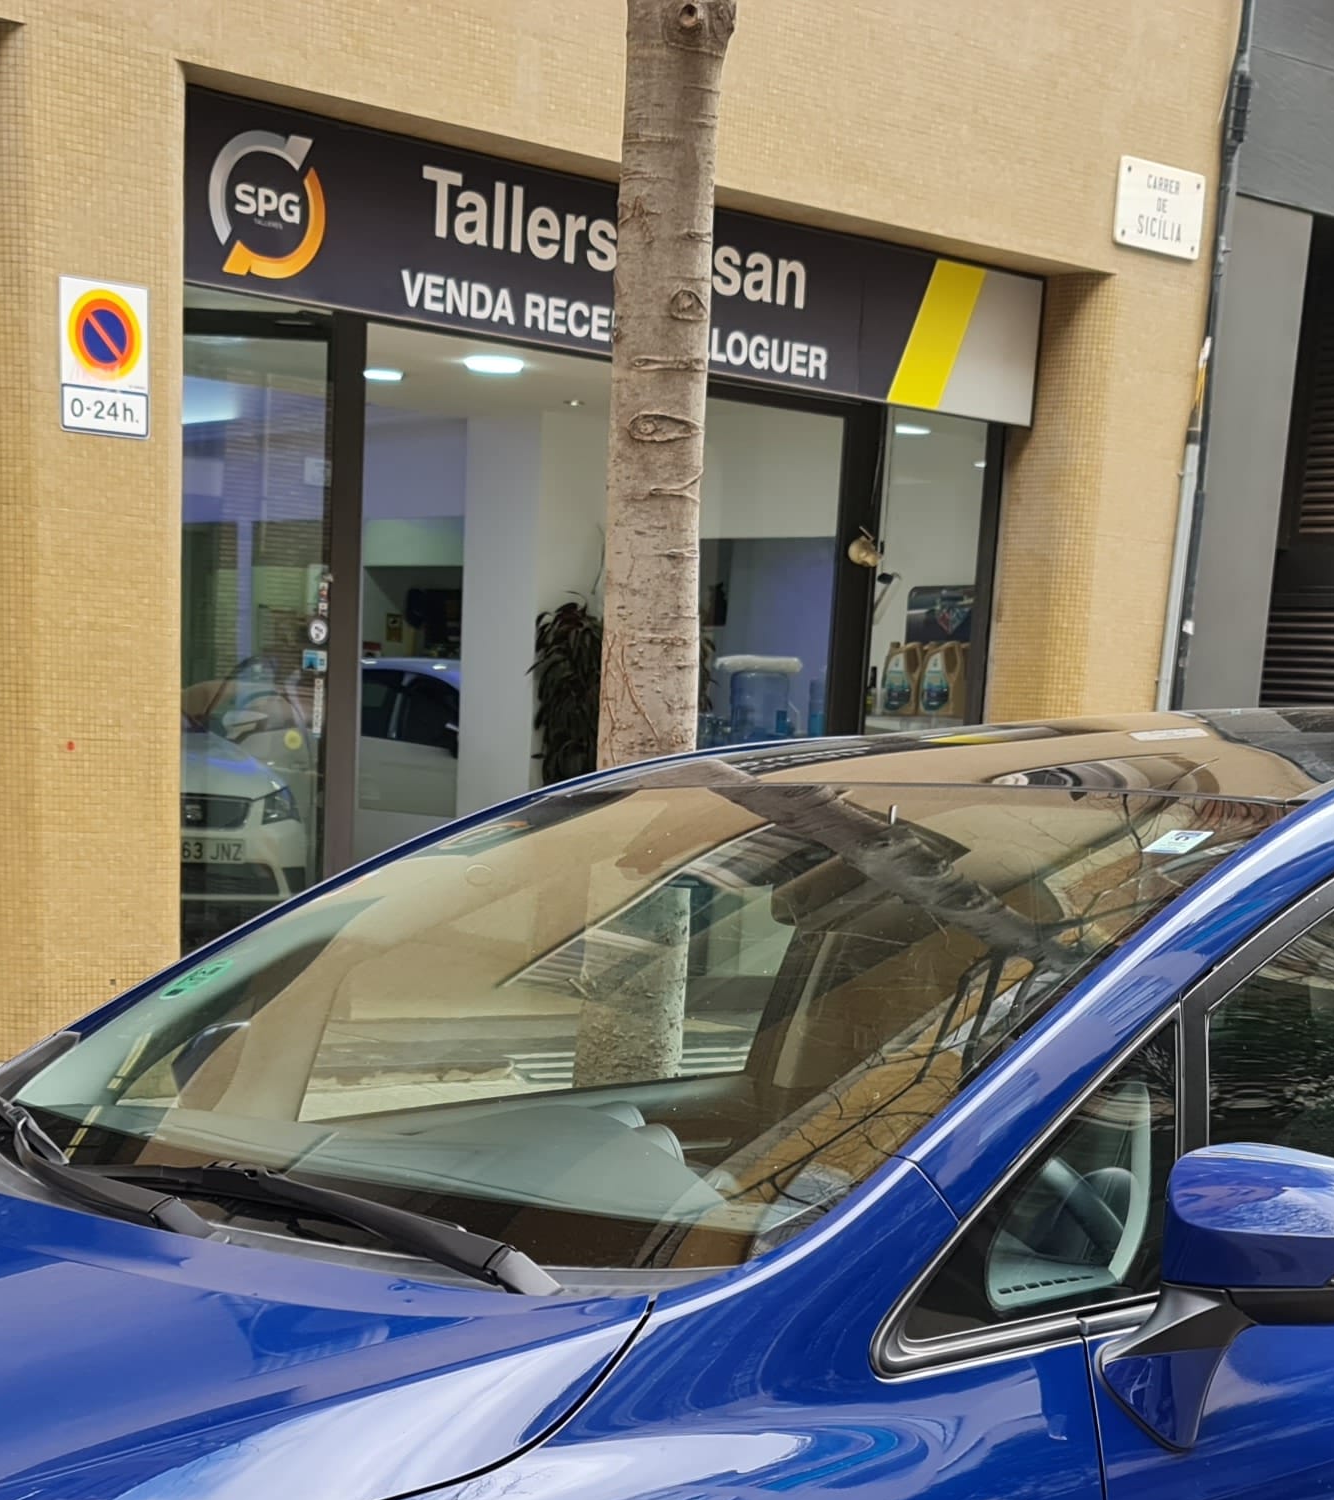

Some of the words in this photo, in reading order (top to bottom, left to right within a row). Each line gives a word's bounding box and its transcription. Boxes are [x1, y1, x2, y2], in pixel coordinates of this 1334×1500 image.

[1147, 174, 1180, 195] CARRER
[234, 182, 301, 225] SPG
[1156, 197, 1168, 213] DE
[422, 165, 618, 272] Tallers
[713, 246, 806, 310] san
[1137, 214, 1182, 243] SICÍLIA
[401, 269, 516, 326] VENDA
[524, 292, 616, 343] RECE
[708, 327, 828, 381] LOGUER
[210, 843, 243, 861] JNZ
